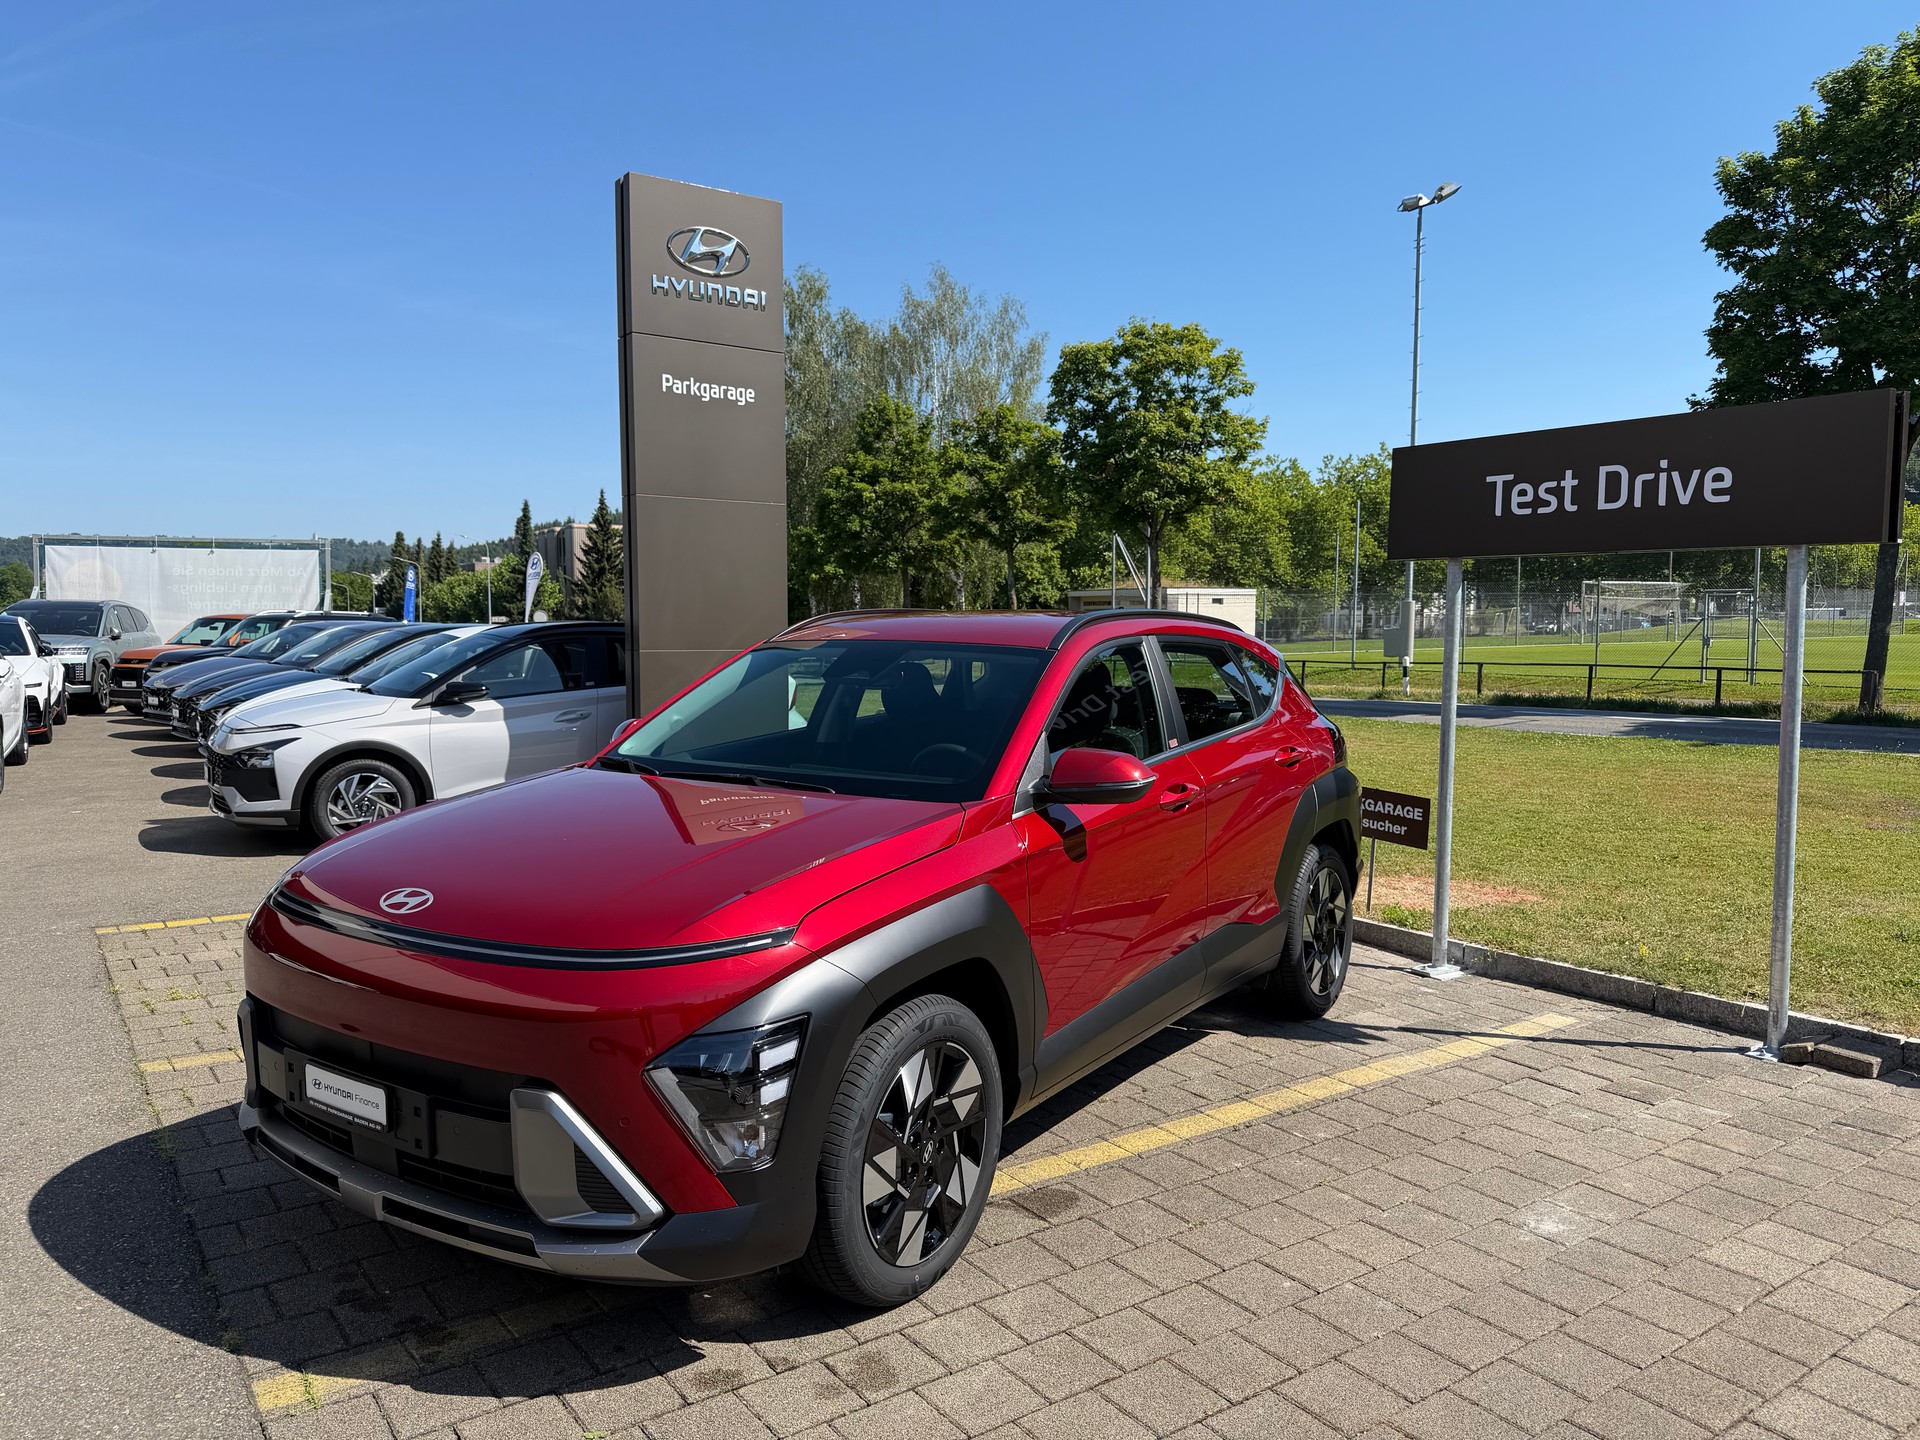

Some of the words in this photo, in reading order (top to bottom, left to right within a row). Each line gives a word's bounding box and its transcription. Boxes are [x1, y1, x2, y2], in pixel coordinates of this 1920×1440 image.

[652, 274, 766, 311] HYUNDAI
[661, 373, 755, 406] Parkgarage
[1485, 469, 1579, 517] Test
[1597, 459, 1733, 510] Drive
[323, 1083, 354, 1101] HYUNDAI
[355, 1094, 380, 1110] Finance
